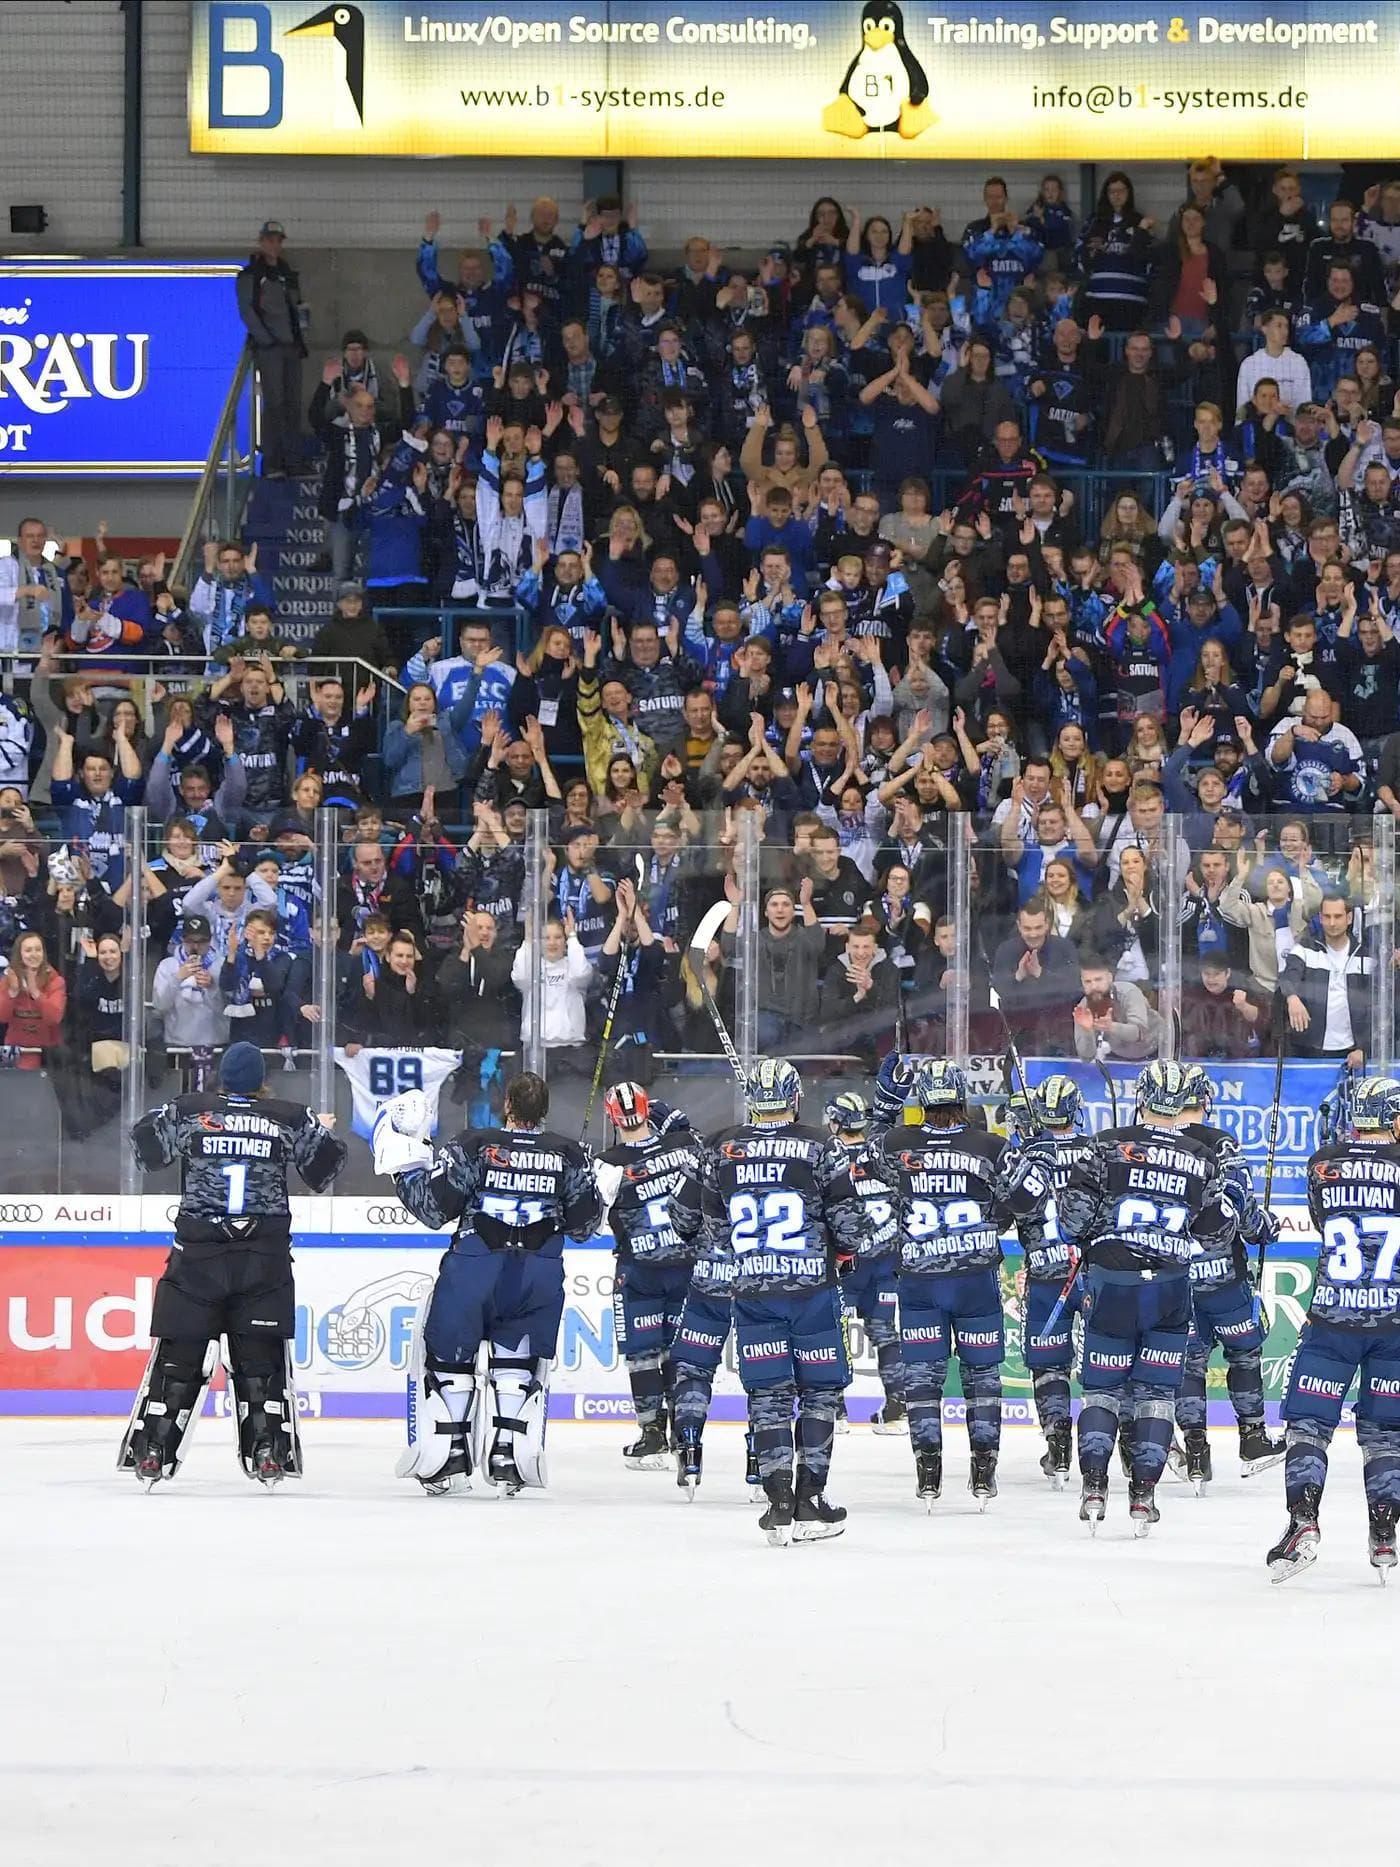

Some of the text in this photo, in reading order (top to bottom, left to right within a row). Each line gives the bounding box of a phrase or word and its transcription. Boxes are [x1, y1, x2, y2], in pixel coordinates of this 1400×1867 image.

[404, 15, 818, 49] Linux/Open Source Consulting,
[928, 16, 1377, 49] Training, Support & Development
[460, 86, 725, 113] www.b1-systems.de
[1032, 85, 1308, 114] info@b1-systems.de
[202, 1136, 272, 1158] STETTMER
[746, 1139, 810, 1159] SATURN
[510, 1150, 563, 1173] SATURN
[923, 1152, 981, 1175] SATURN
[1147, 1146, 1205, 1177] SATURN
[485, 1170, 556, 1195] PIELMEIER
[735, 1163, 787, 1185] BAILEY
[911, 1171, 967, 1194] HÖFFLIN
[1128, 1168, 1188, 1196] ELSNER
[222, 1164, 247, 1215] 1
[1321, 1186, 1395, 1209] SULLIVAN
[54, 1205, 113, 1222] Audi
[728, 1191, 807, 1254] 22
[922, 1230, 998, 1257] INGOLSTADT
[681, 1327, 723, 1346] CINQUE
[902, 1325, 942, 1341] CINQUE
[958, 1330, 999, 1344] CINQUE
[742, 1340, 788, 1356] CINQUE
[1089, 1351, 1133, 1367] CINQUE
[1140, 1347, 1182, 1366] CINQUE
[1298, 1374, 1345, 1397] CINQUE
